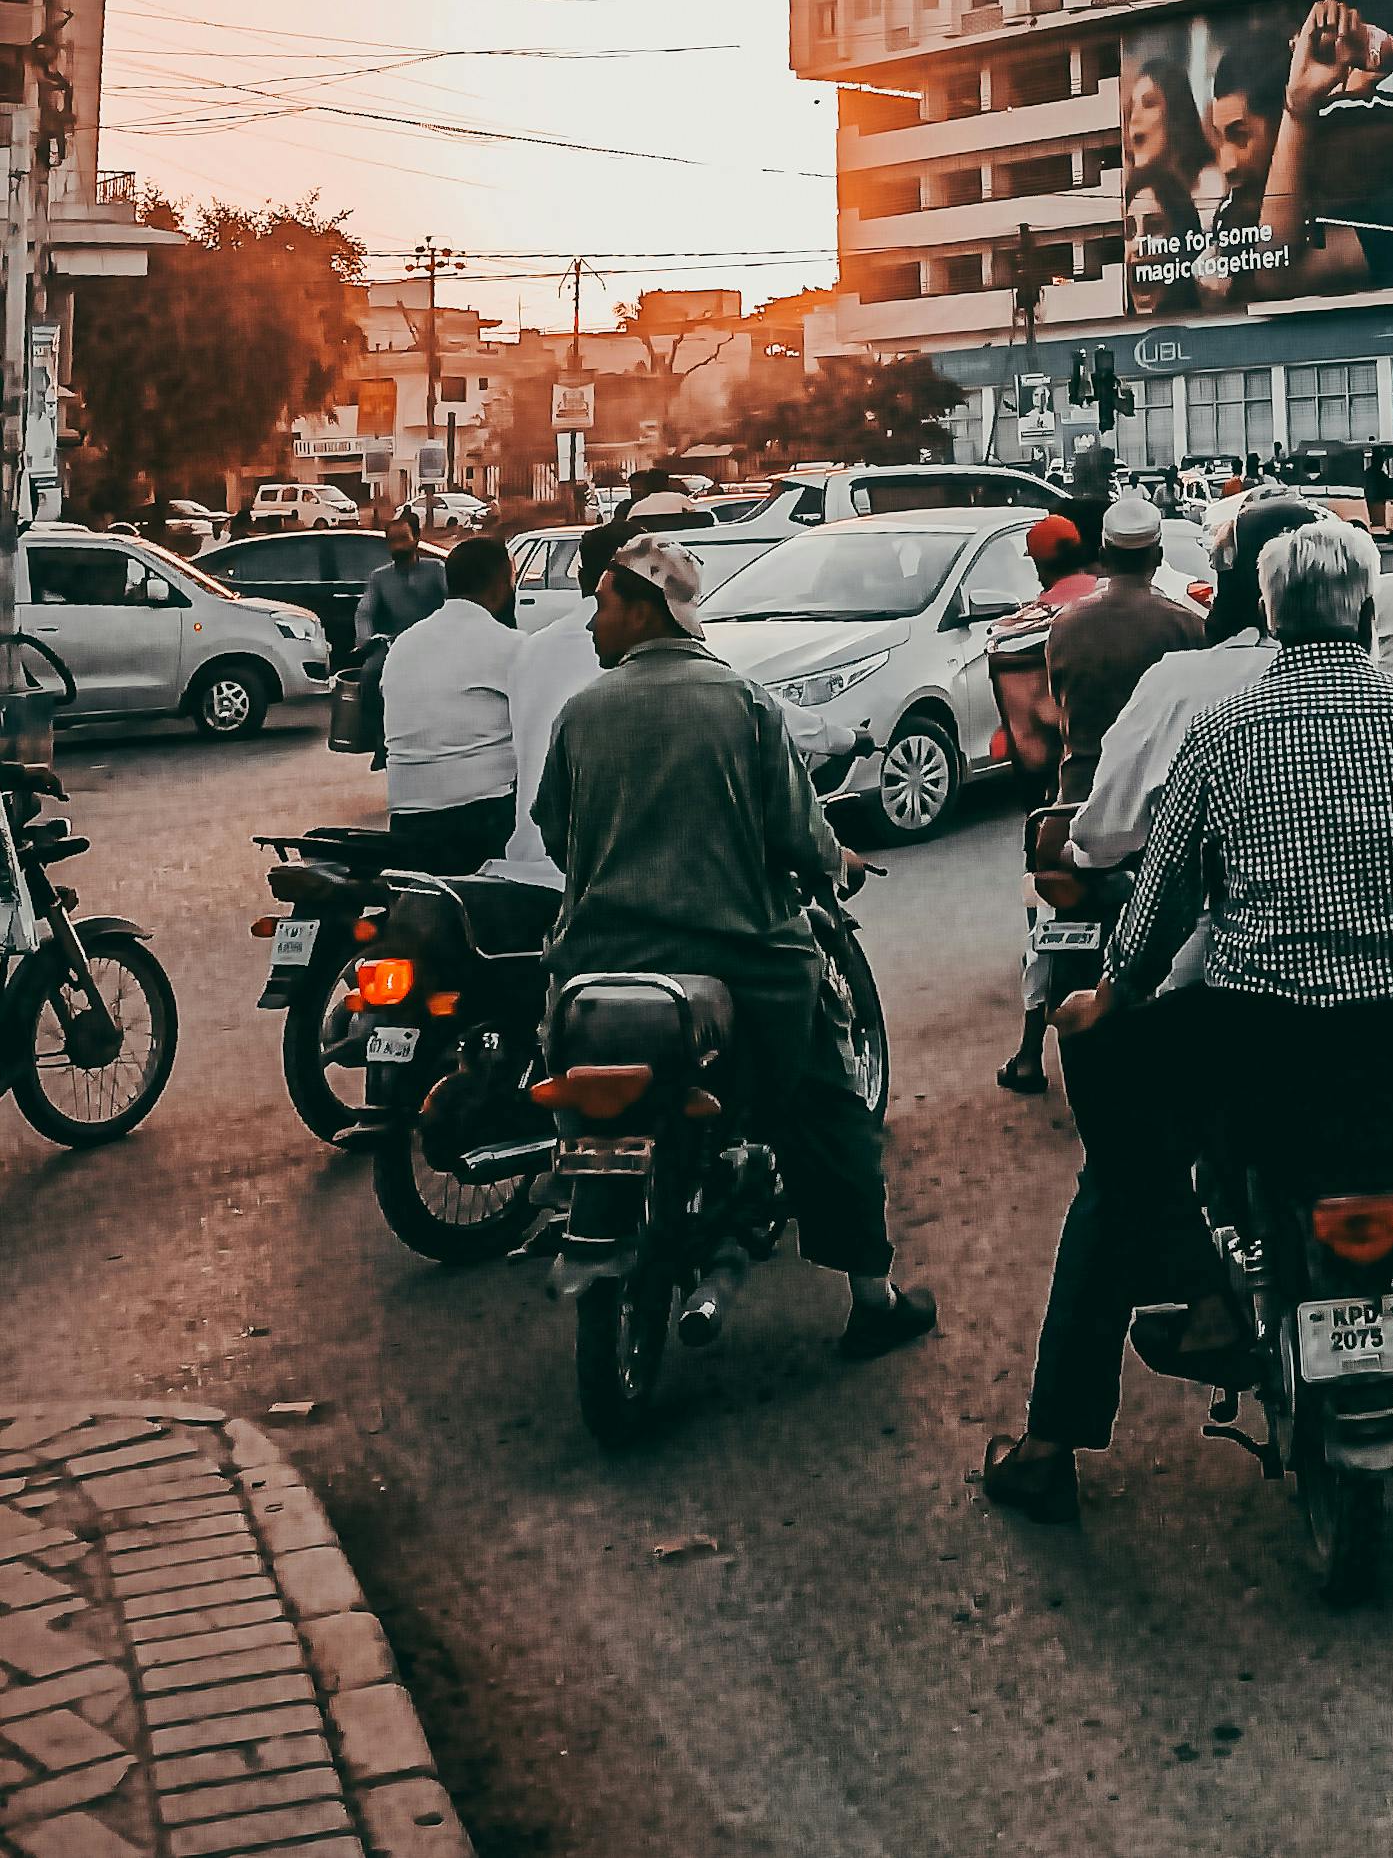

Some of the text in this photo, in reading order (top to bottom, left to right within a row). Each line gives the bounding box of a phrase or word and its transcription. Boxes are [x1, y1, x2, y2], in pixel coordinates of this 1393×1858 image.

[1136, 224, 1273, 257] Time for some
[1135, 244, 1290, 285] magic together!
[1142, 341, 1193, 363] UBL
[1331, 1304, 1380, 1329] KPD
[1330, 1327, 1384, 1352] 2075
